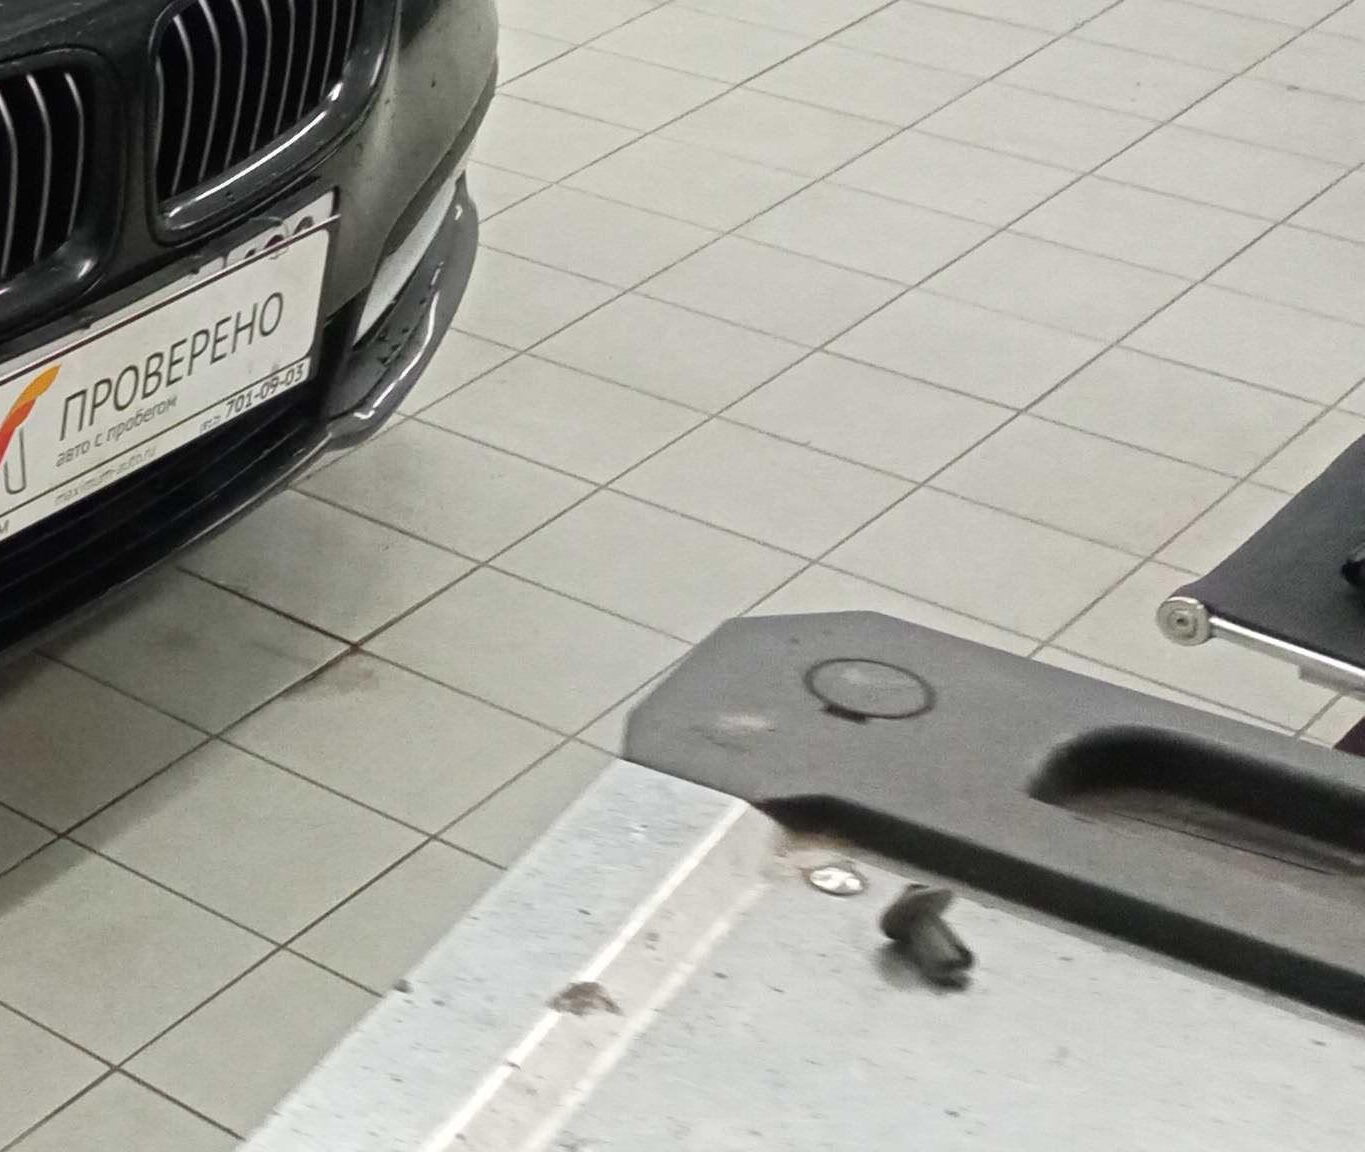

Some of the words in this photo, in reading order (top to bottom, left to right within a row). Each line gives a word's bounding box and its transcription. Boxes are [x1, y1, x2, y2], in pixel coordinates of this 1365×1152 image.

[59, 291, 284, 441] ПРОВЕРЕНО
[226, 362, 304, 417] 701-09-03
[55, 439, 90, 467] авто
[94, 432, 104, 448] с
[106, 395, 177, 443] пробегом
